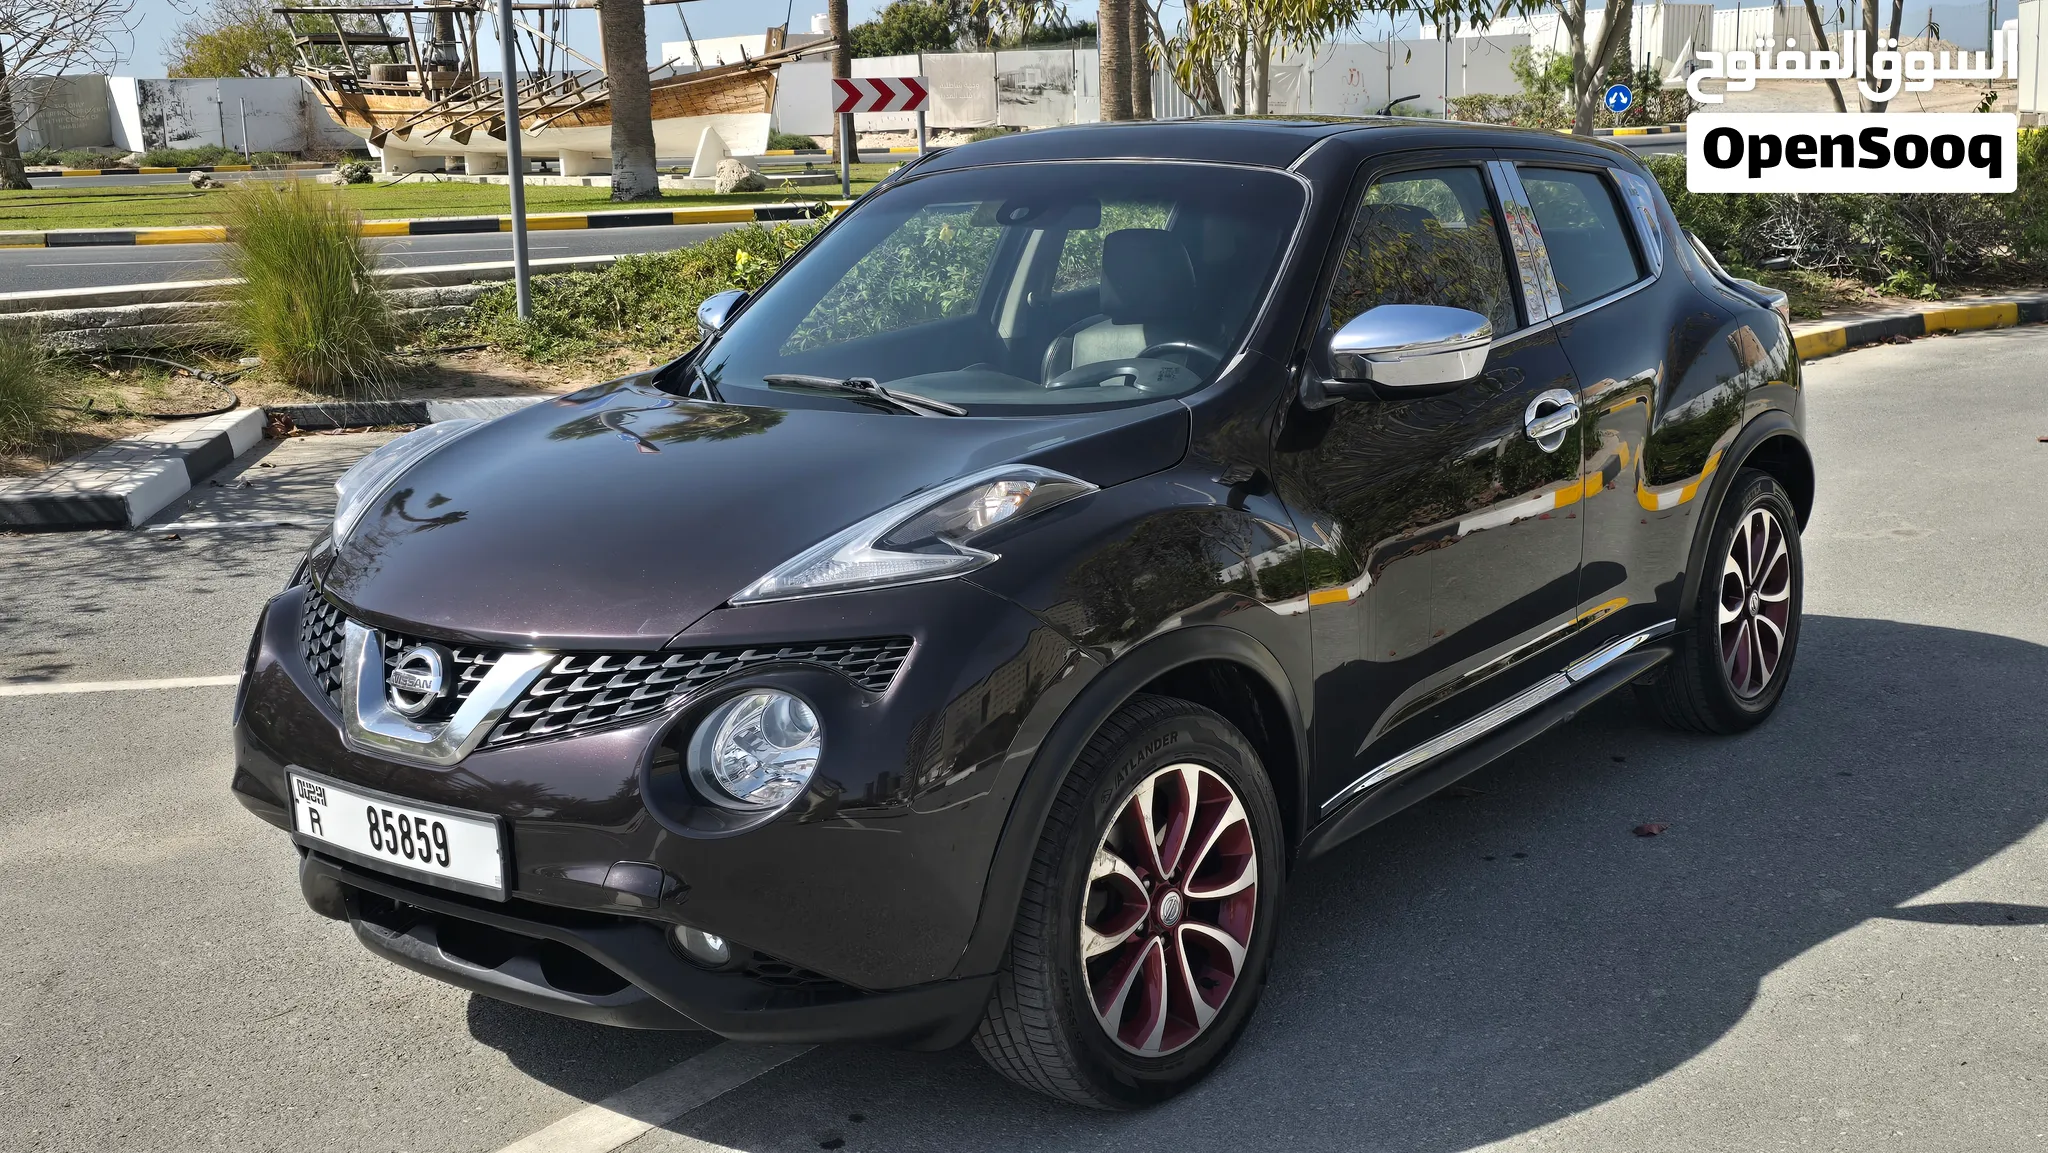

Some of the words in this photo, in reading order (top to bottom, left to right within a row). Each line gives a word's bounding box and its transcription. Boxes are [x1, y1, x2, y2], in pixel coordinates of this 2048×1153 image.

[393, 672, 433, 689] NISSAN
[1114, 731, 1180, 788] ATLANDER
[309, 807, 323, 836] R
[366, 805, 450, 868] 85859
